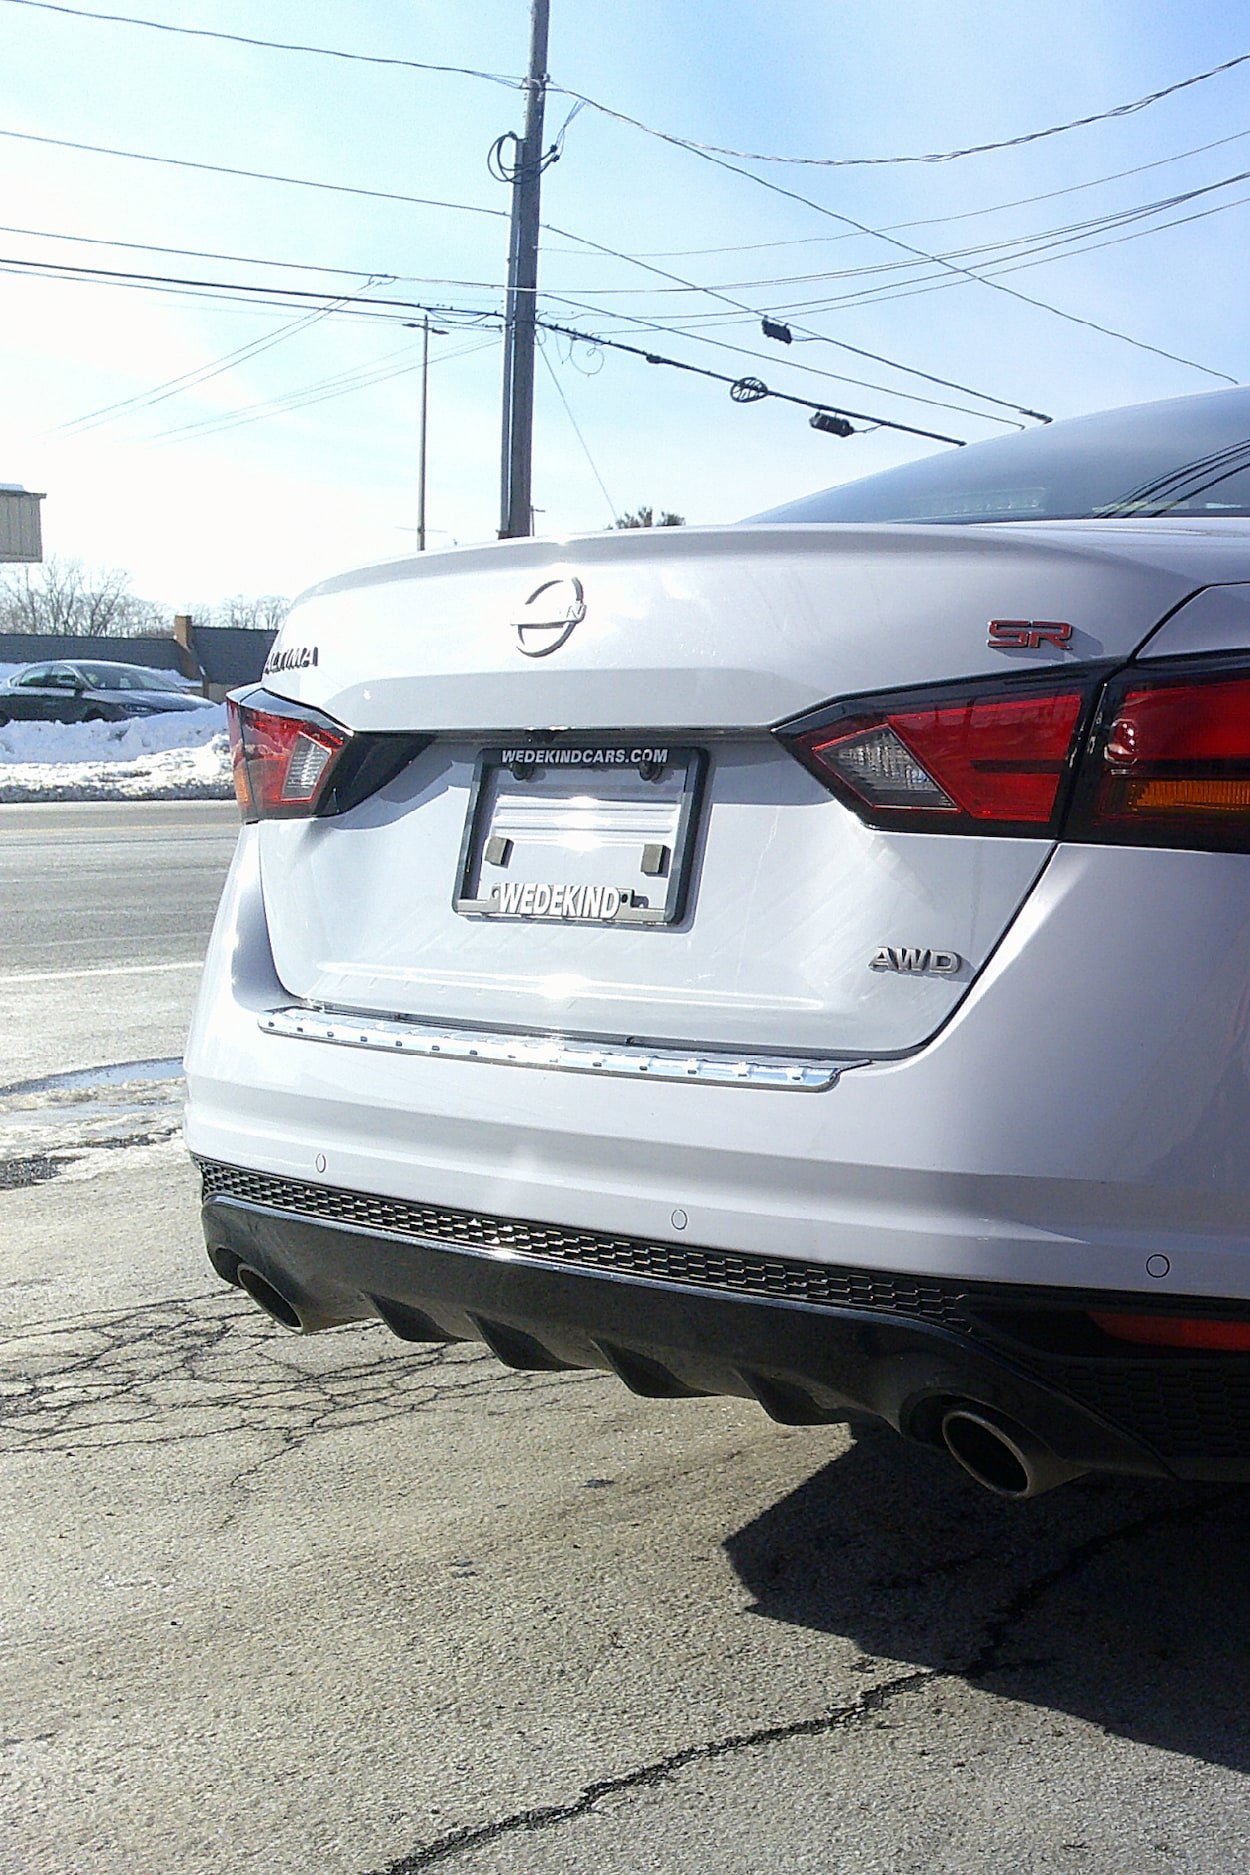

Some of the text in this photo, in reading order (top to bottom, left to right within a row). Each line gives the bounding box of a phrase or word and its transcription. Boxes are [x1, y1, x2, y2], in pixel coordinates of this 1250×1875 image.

[986, 619, 1072, 650] SR
[501, 749, 668, 764] WEDEKINDCARS.COM
[499, 883, 621, 919] WEDEKIND
[868, 946, 960, 974] AWD
